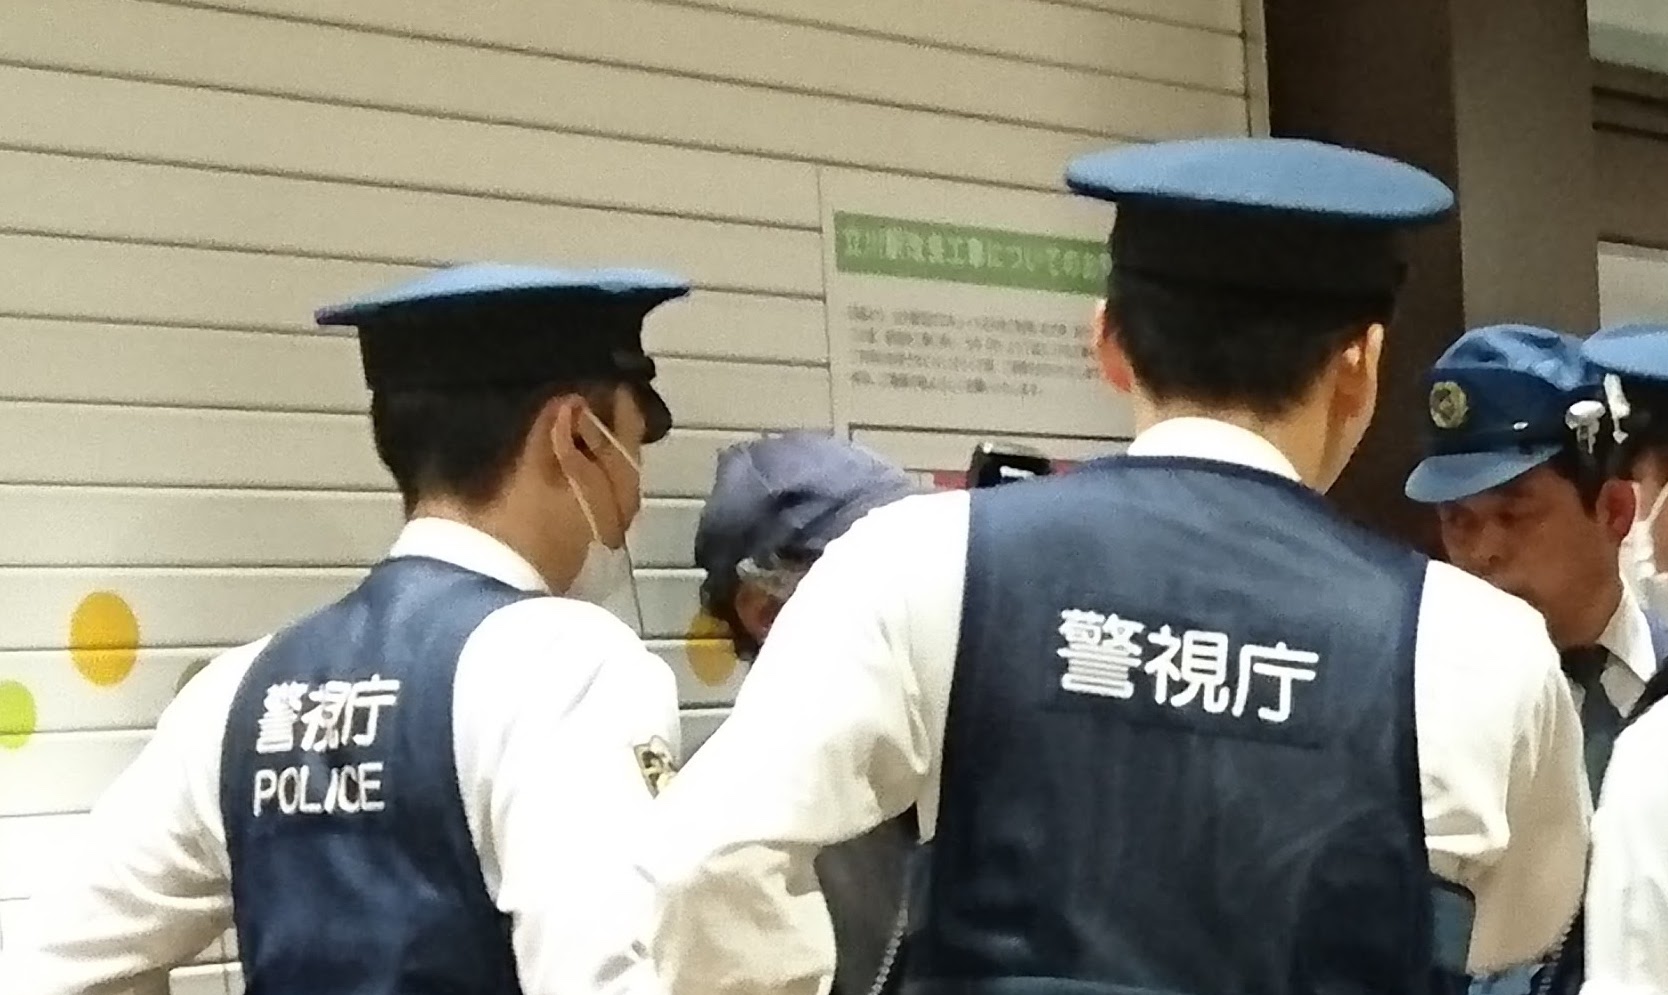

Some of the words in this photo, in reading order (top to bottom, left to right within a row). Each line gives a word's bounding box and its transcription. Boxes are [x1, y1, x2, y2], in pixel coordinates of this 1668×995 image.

[1056, 608, 1319, 723] 警視庁
[256, 673, 400, 754] 警視庁
[253, 762, 385, 817] POLICE
